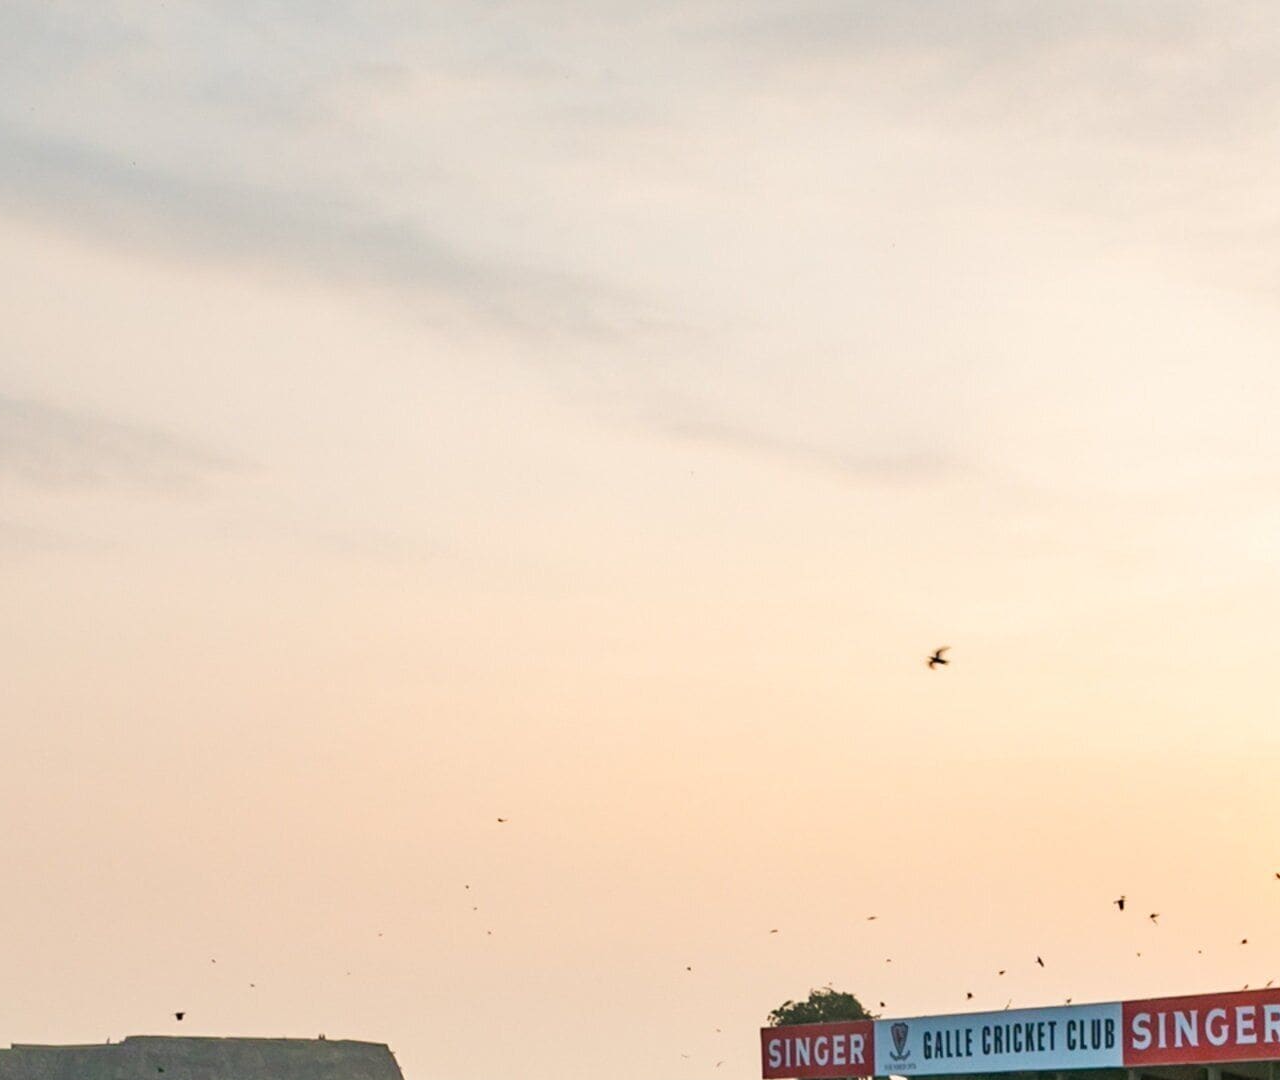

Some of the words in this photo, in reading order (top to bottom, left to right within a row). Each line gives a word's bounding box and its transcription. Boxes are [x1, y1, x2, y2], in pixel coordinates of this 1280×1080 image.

[768, 1033, 866, 1068] SINGER
[923, 1028, 973, 1060] GALLE
[981, 1021, 1057, 1055] CRICKET
[1067, 1018, 1116, 1051] CLUB
